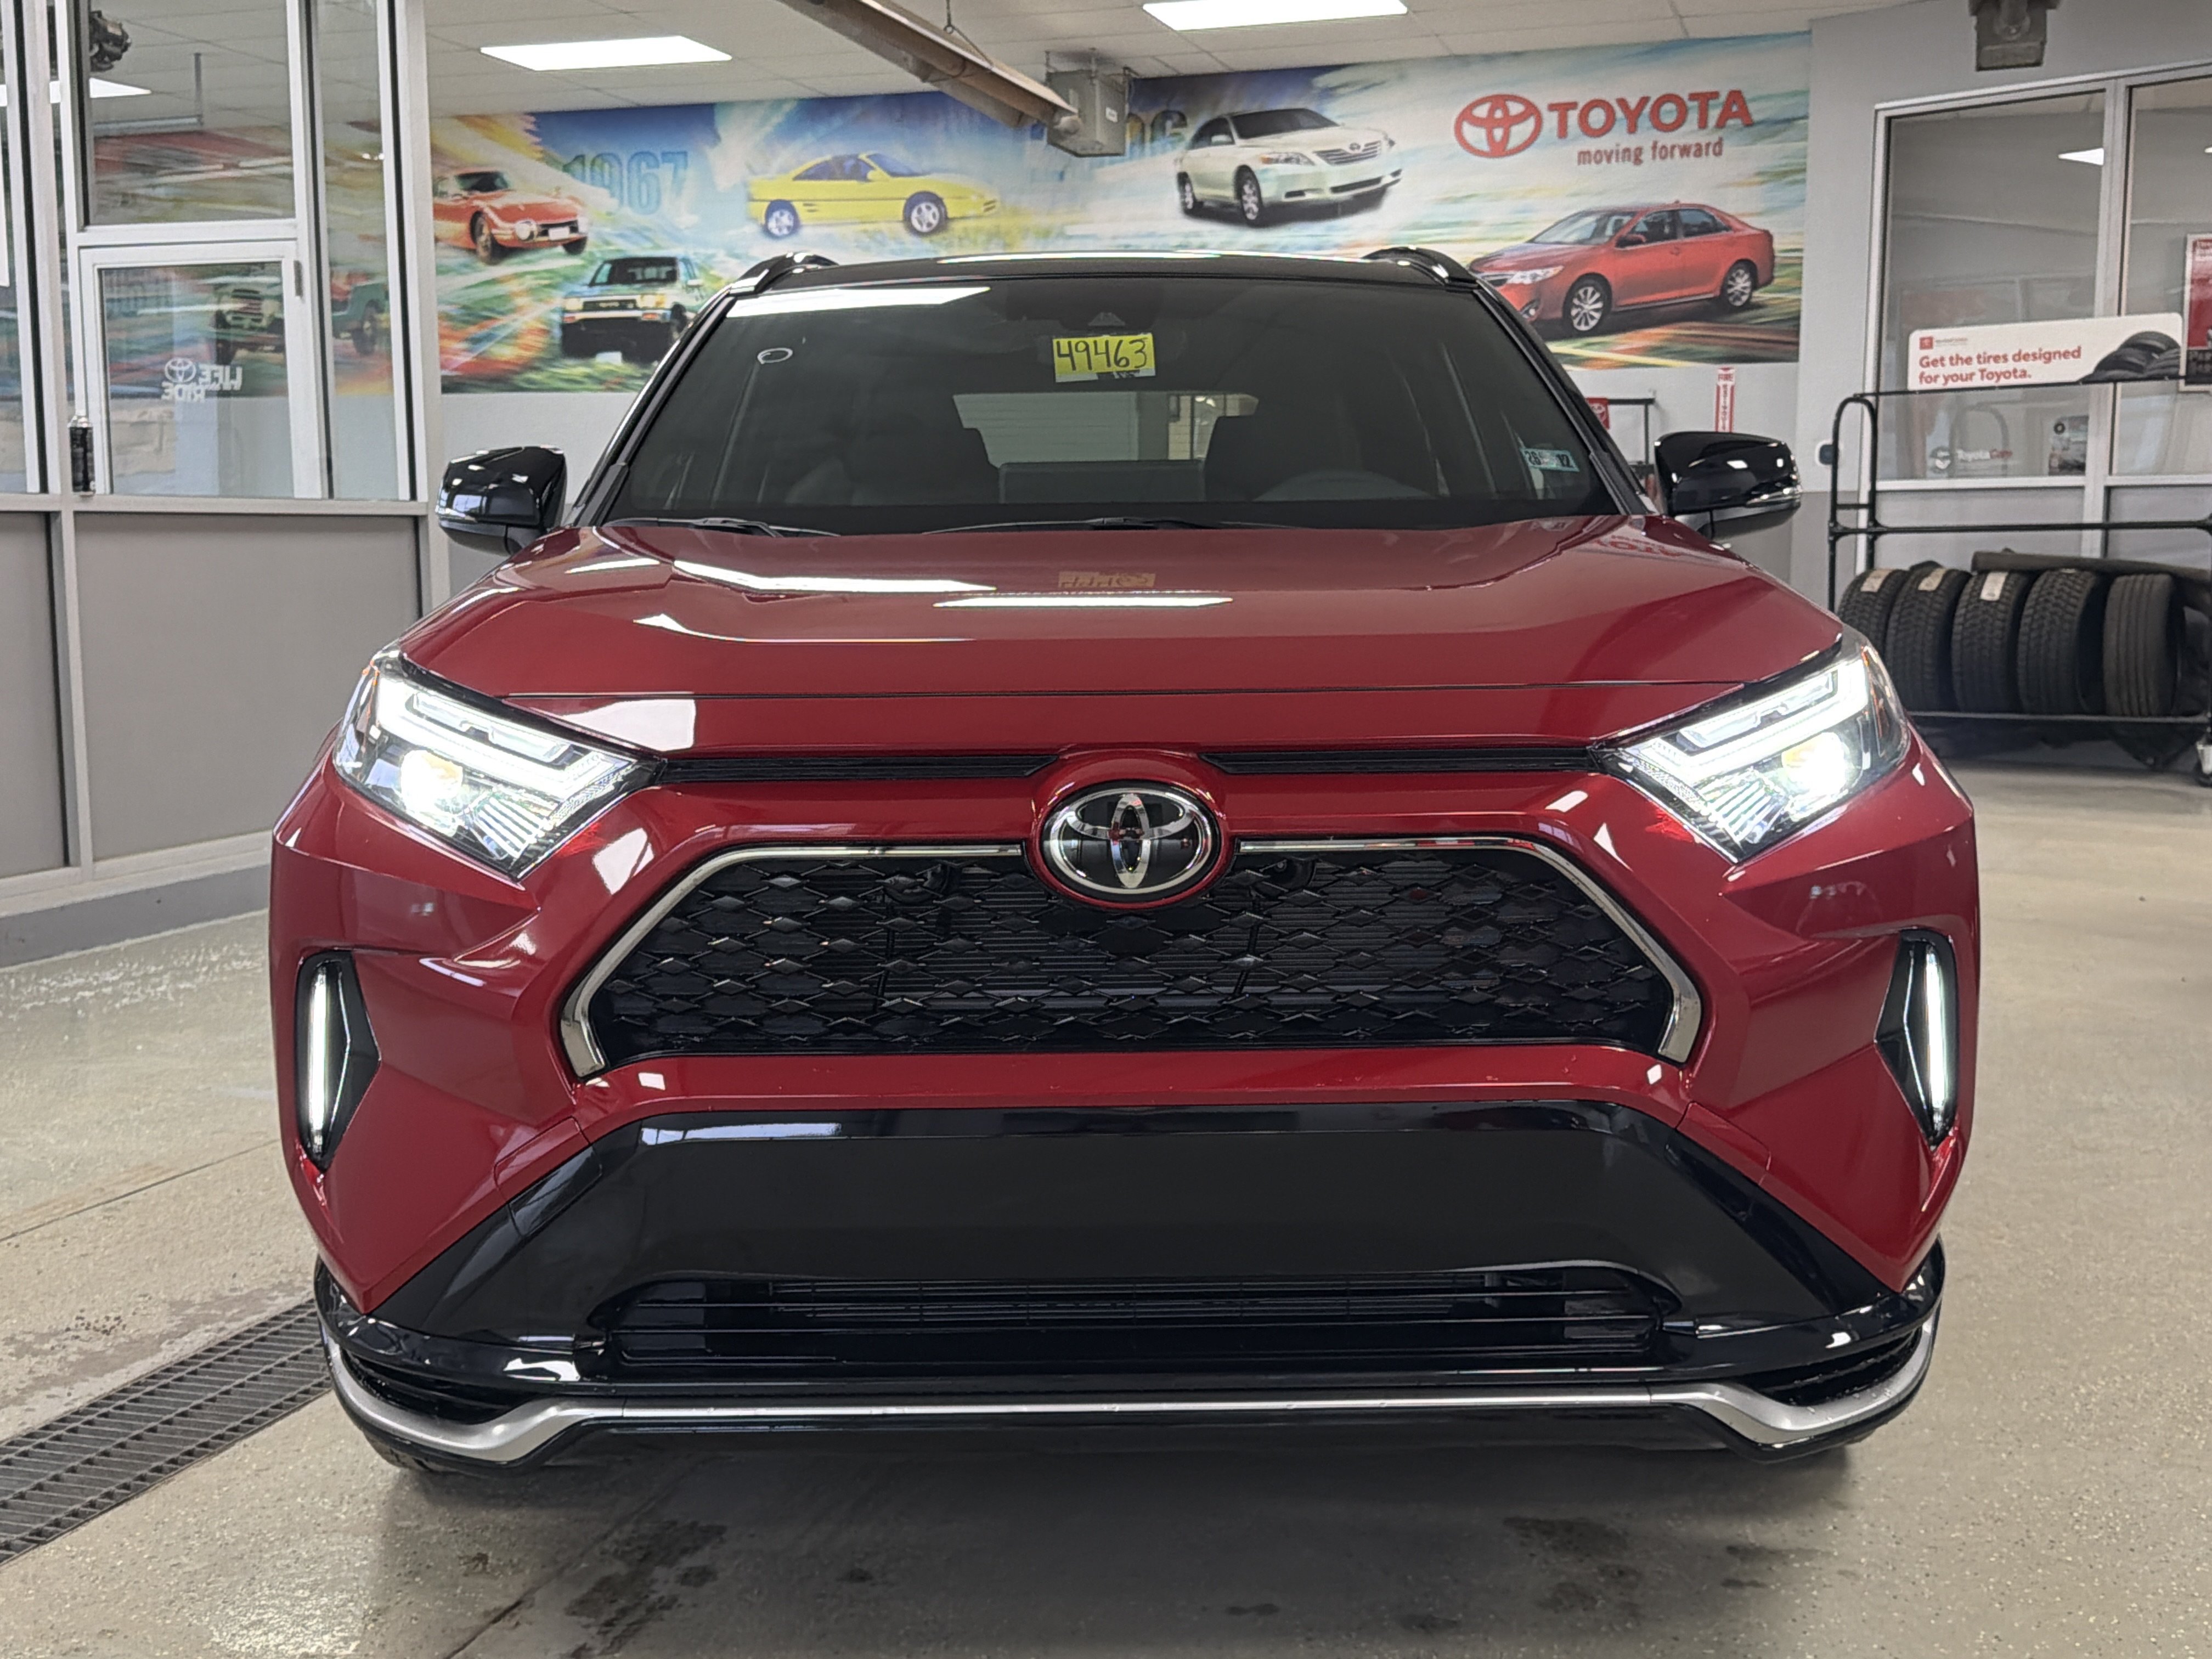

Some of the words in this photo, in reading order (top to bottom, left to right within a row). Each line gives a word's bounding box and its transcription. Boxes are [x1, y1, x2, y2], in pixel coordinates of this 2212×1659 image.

[1547, 89, 1754, 139] TOYOTA
[1577, 143, 1643, 165] moving
[1651, 137, 1723, 160] forward
[1056, 337, 1148, 371] 49463
[1920, 356, 1946, 368] Get
[1949, 353, 1973, 366] the
[1976, 351, 2008, 364] tires
[2012, 346, 2082, 364] designed
[1919, 371, 1939, 384] for
[1942, 372, 1975, 386] your
[1978, 367, 2032, 383] Toyota.
